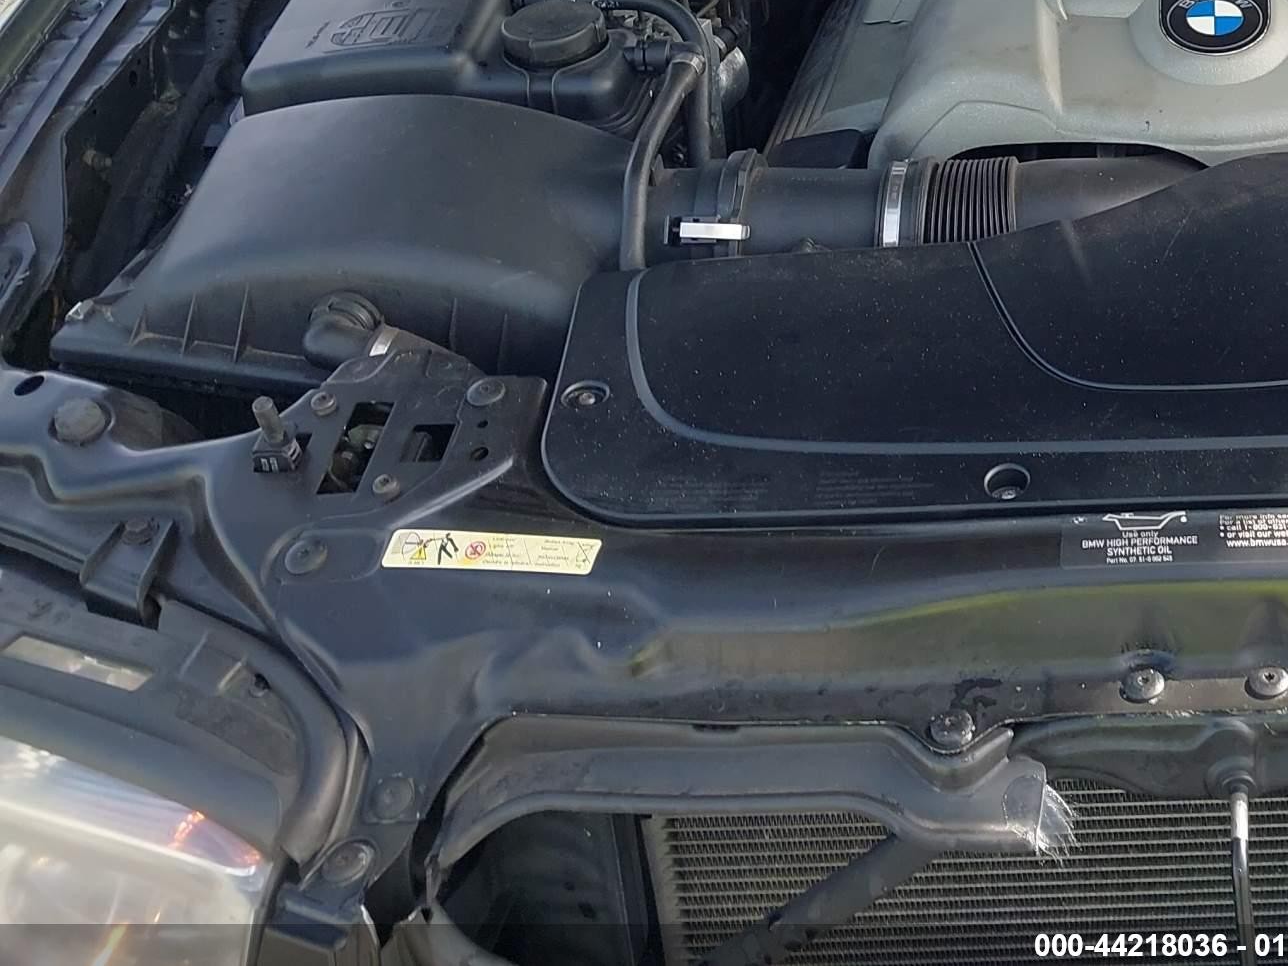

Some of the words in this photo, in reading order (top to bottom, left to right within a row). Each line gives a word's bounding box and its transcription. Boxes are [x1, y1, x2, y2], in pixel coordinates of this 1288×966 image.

[1140, 530, 1159, 539] only
[1237, 530, 1256, 538] visit
[1082, 539, 1105, 549] BMW
[1106, 538, 1129, 548] HIGH
[1130, 536, 1198, 547] PERFORMANCE
[1106, 546, 1156, 557] SYNTHETIC
[1157, 545, 1173, 555] OIL
